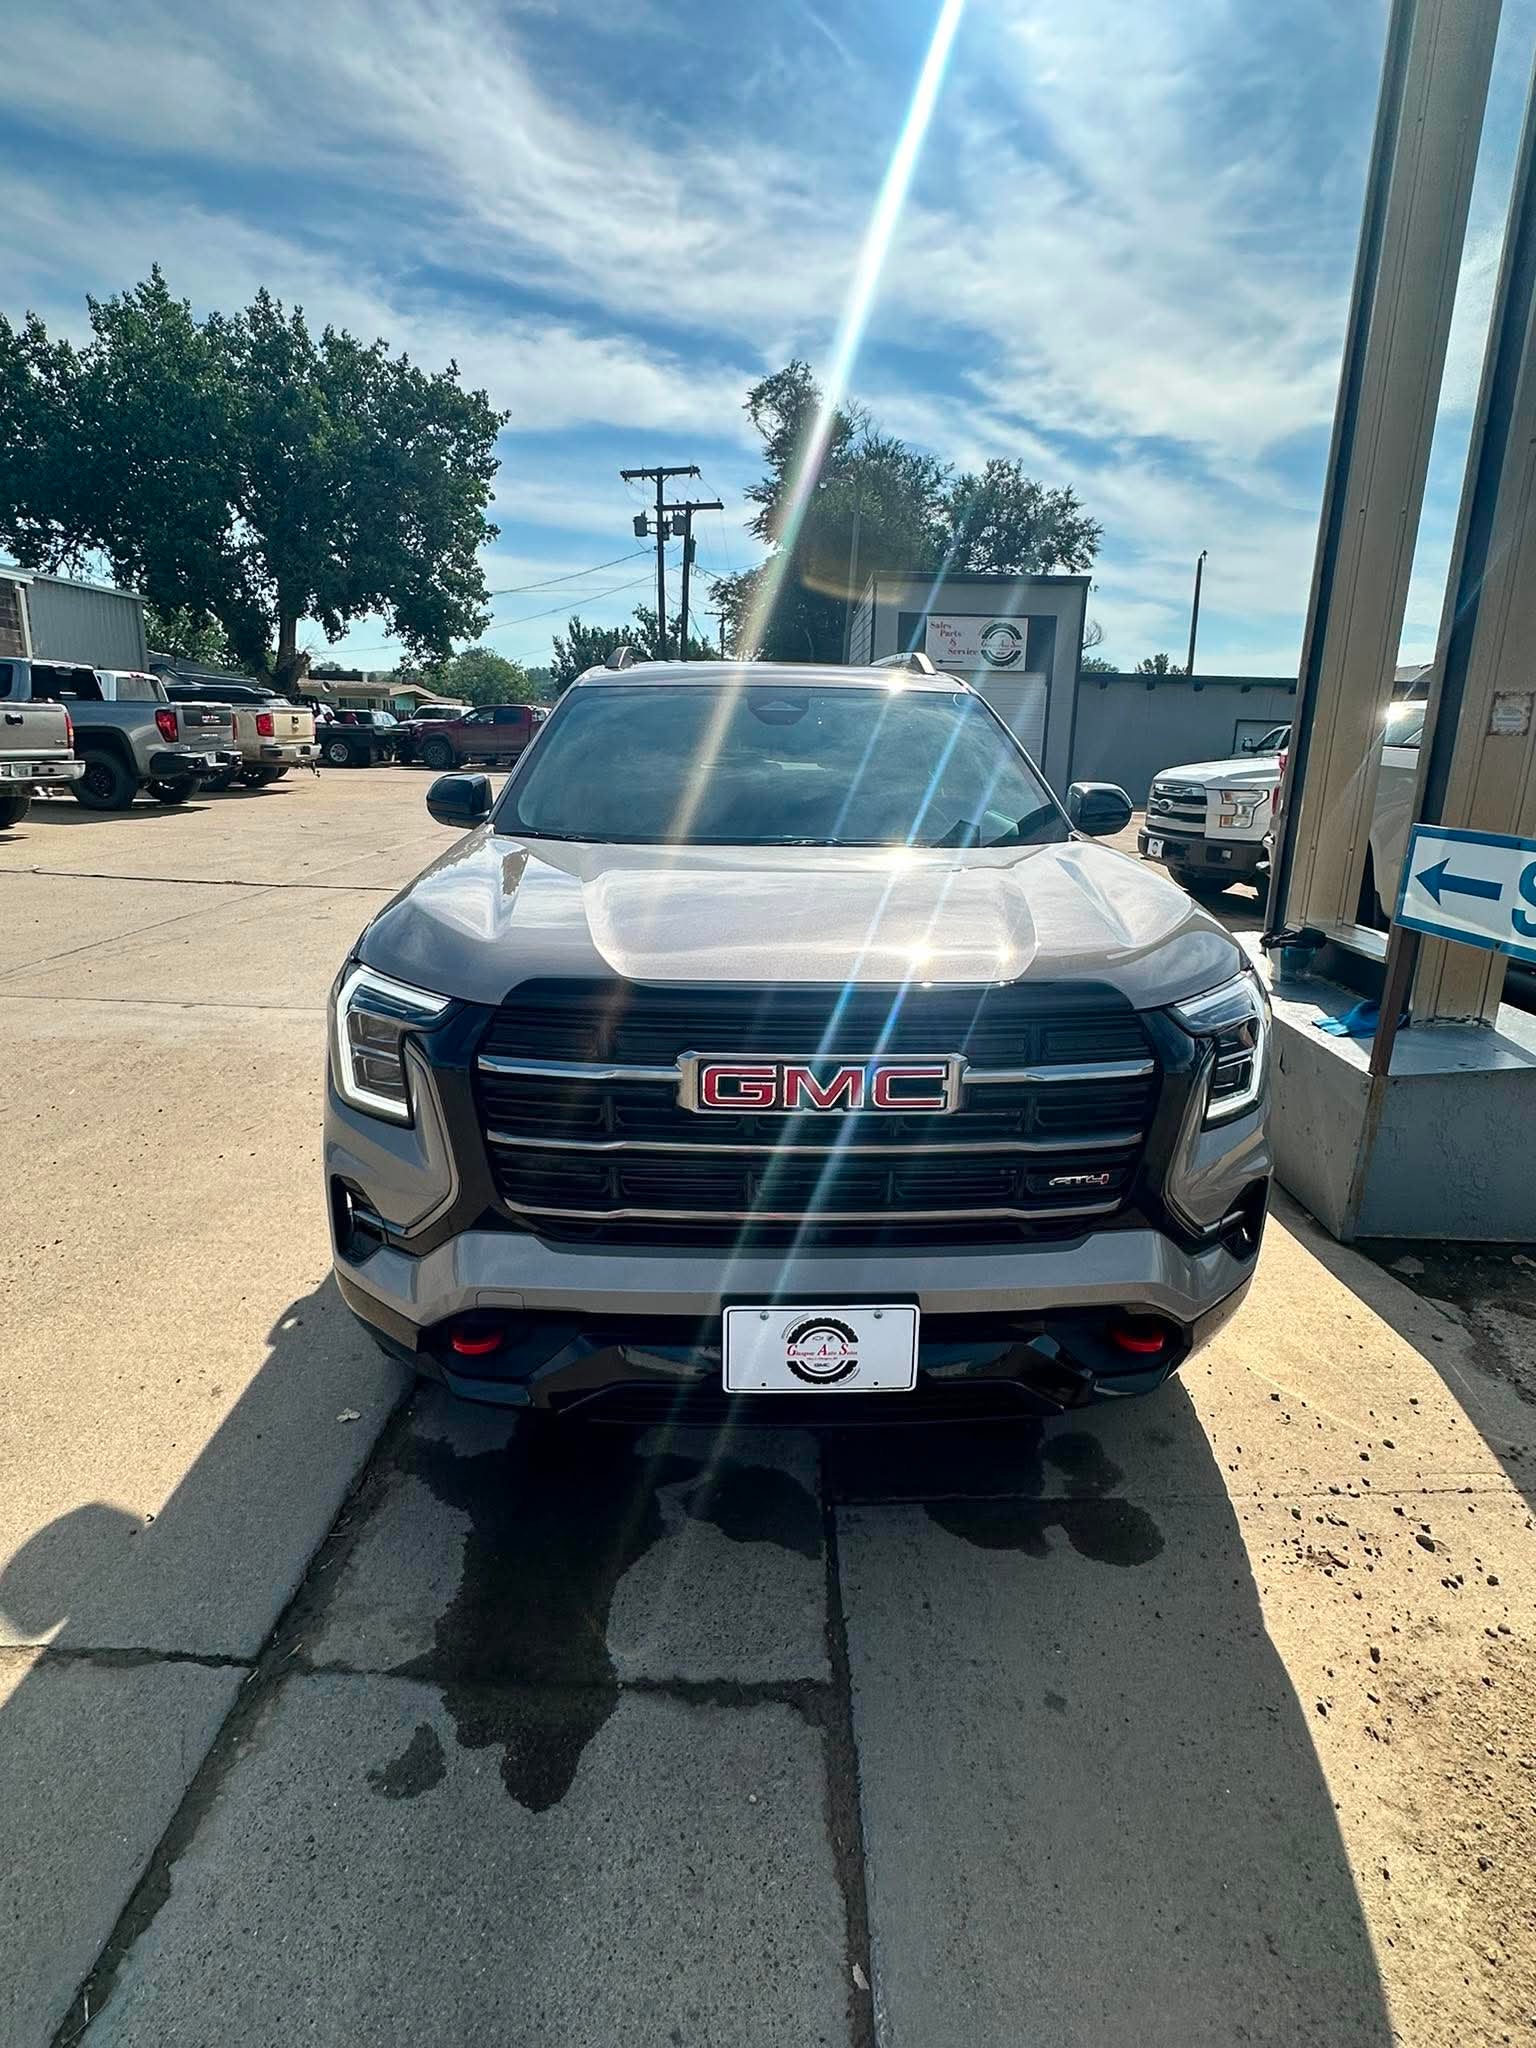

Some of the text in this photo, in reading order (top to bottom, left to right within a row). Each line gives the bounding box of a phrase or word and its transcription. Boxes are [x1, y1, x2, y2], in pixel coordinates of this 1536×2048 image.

[930, 621, 952, 630] Sales
[940, 630, 962, 638] Parts
[947, 648, 979, 656] Service
[702, 1065, 947, 1109] GMC
[1049, 1173, 1110, 1186] AT4
